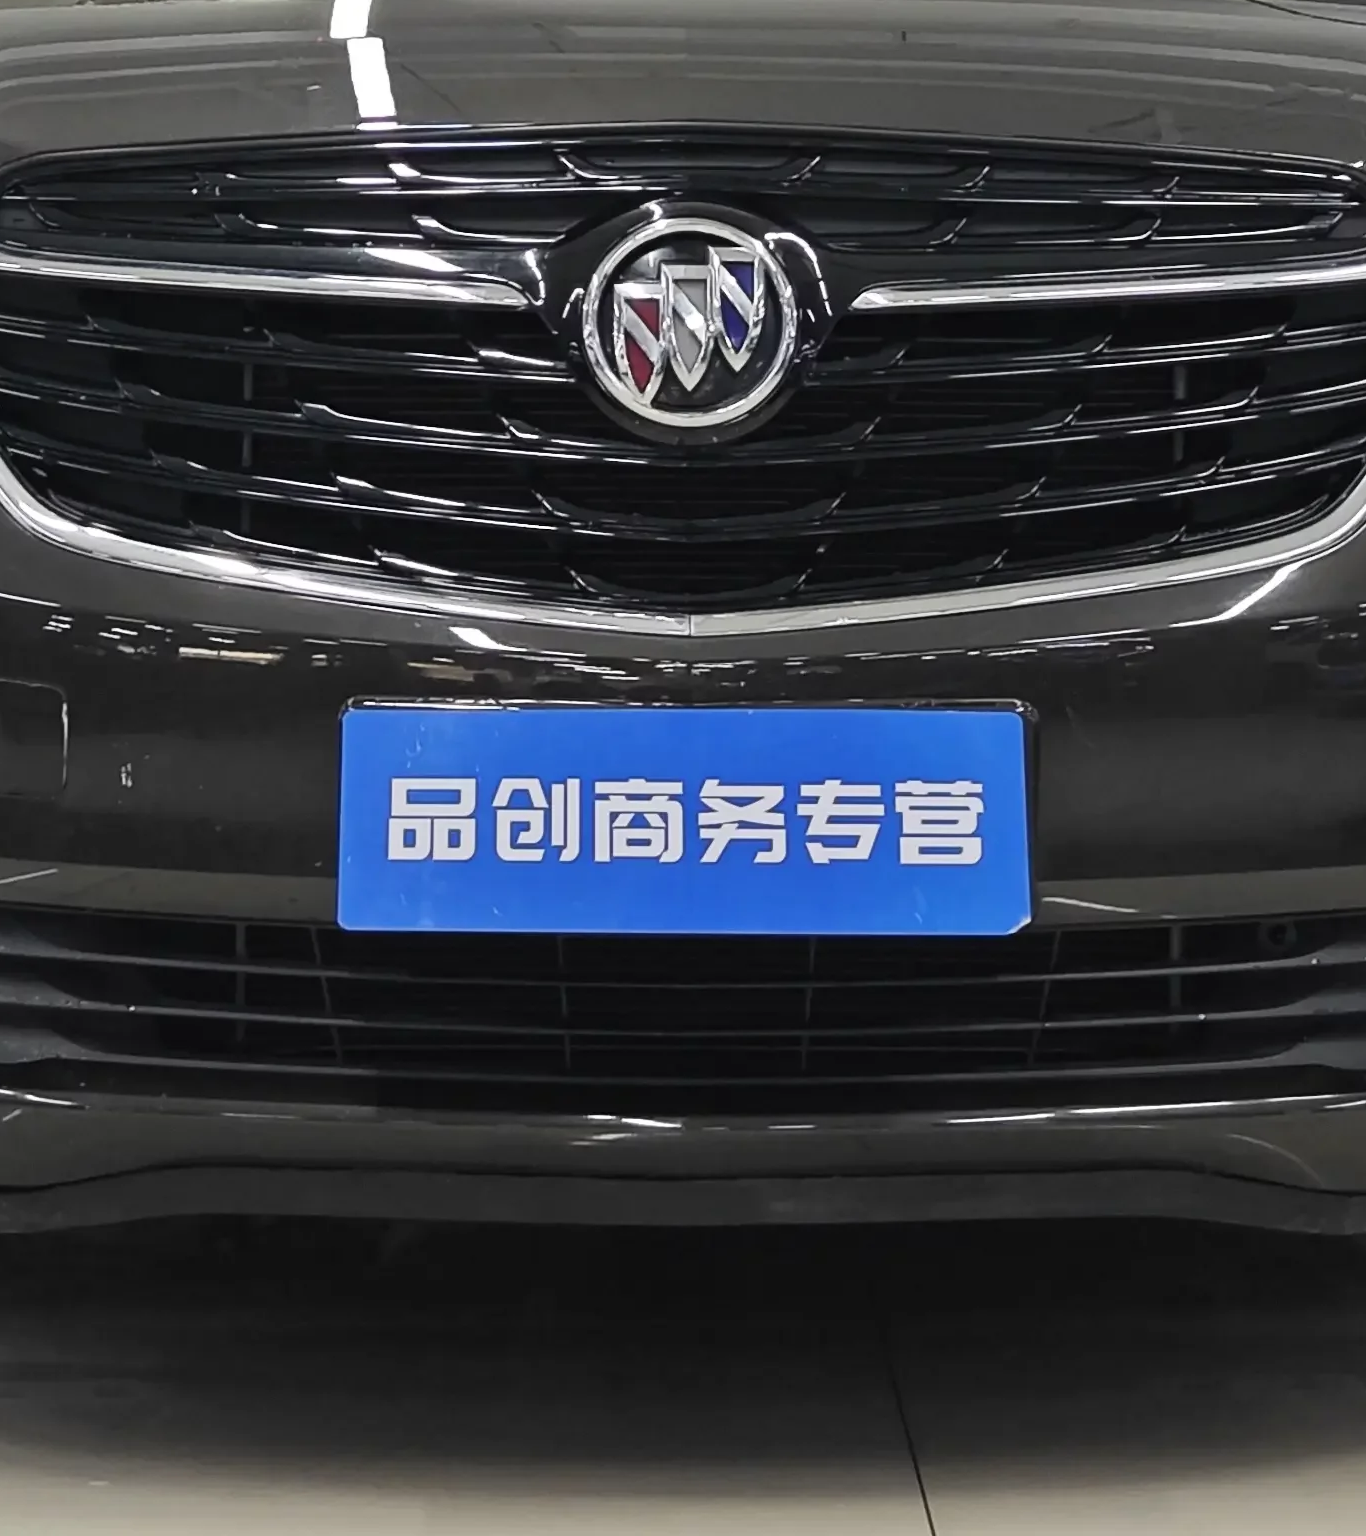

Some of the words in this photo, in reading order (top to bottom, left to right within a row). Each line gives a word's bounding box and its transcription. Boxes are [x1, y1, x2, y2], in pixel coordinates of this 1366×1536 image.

[386, 777, 985, 865] 品创商务专营
